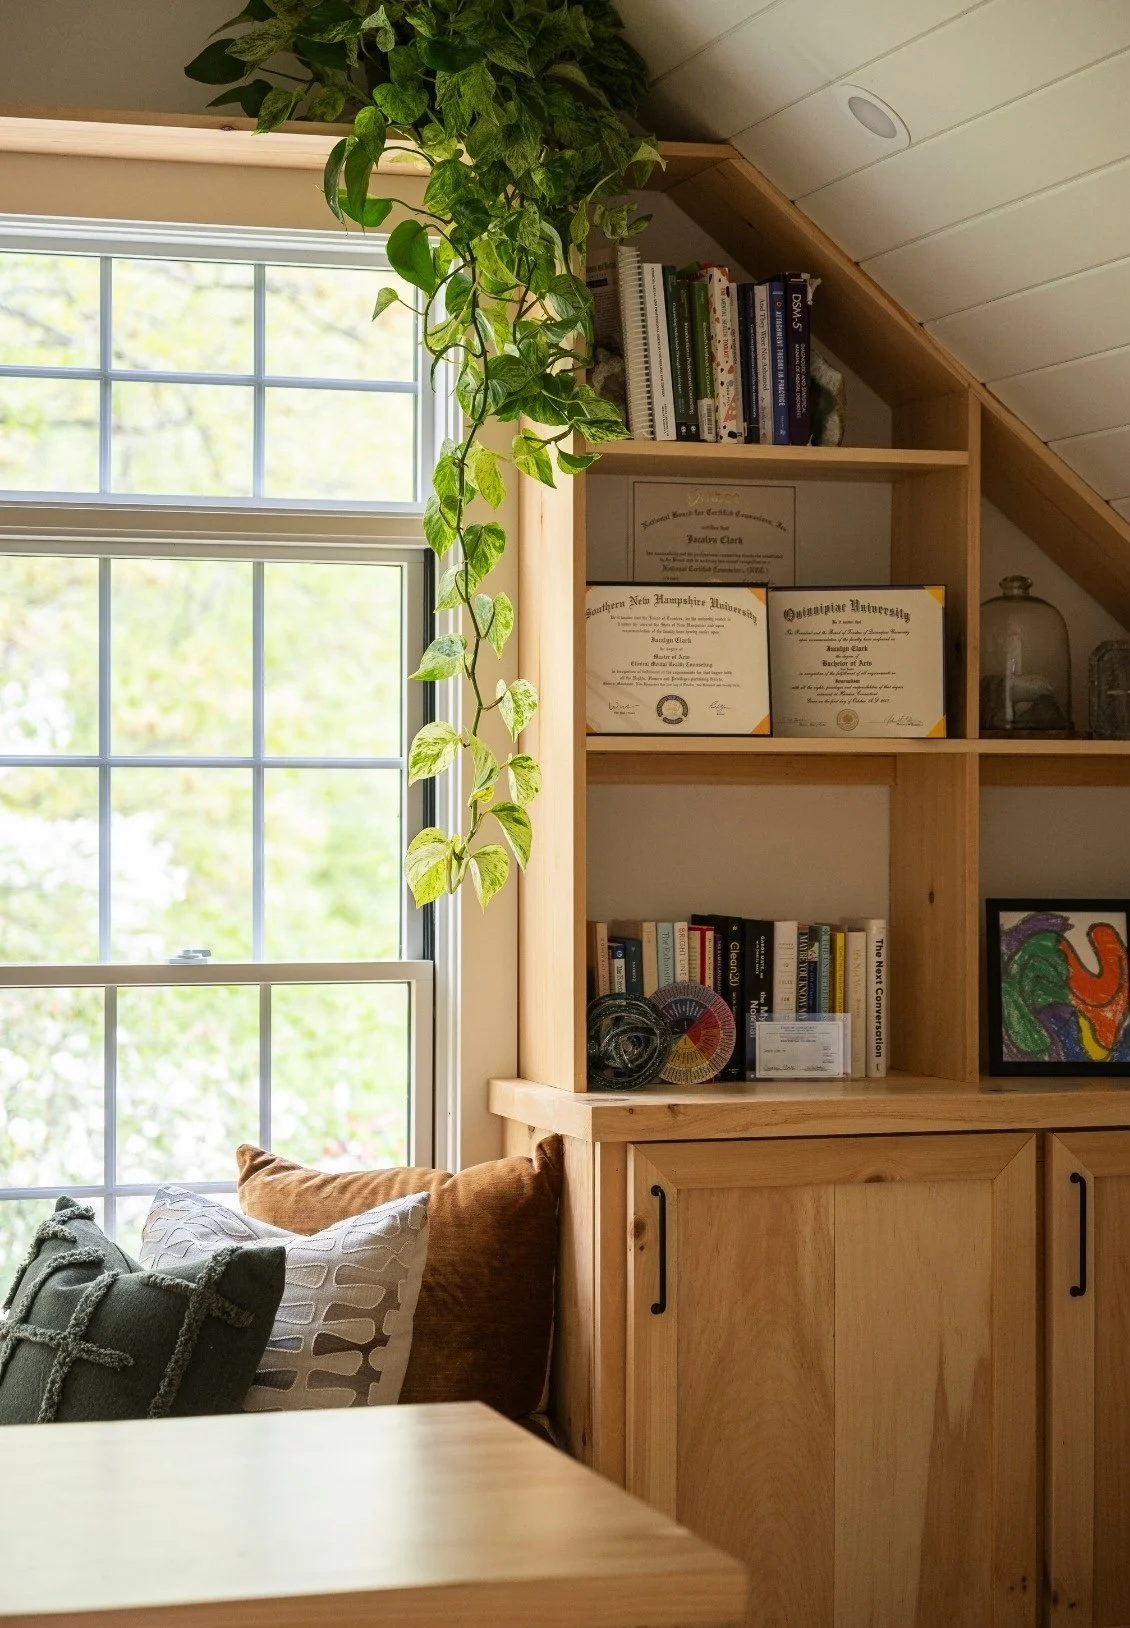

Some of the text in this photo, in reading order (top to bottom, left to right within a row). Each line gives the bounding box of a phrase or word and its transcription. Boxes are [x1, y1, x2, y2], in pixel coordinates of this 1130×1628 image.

[791, 293, 801, 329] DSM-5
[775, 311, 784, 347] ATTACHMENT
[776, 349, 784, 370] THEORY
[778, 380, 786, 406] PRACTICE
[641, 514, 670, 529] National
[671, 511, 693, 519] Board
[687, 535, 743, 545] Jacalyn Clark
[586, 601, 625, 619] Southern
[629, 595, 650, 609] New
[653, 593, 706, 608] Hampshire
[710, 597, 758, 626] University
[784, 599, 911, 624] Quinnipiac University
[661, 932, 670, 945] The
[799, 934, 808, 961] MAYBE
[799, 963, 808, 981] YOU
[799, 981, 808, 1007] KNOW
[875, 939, 884, 1058] The Next Conversation
[749, 1000, 758, 1038] Normal
